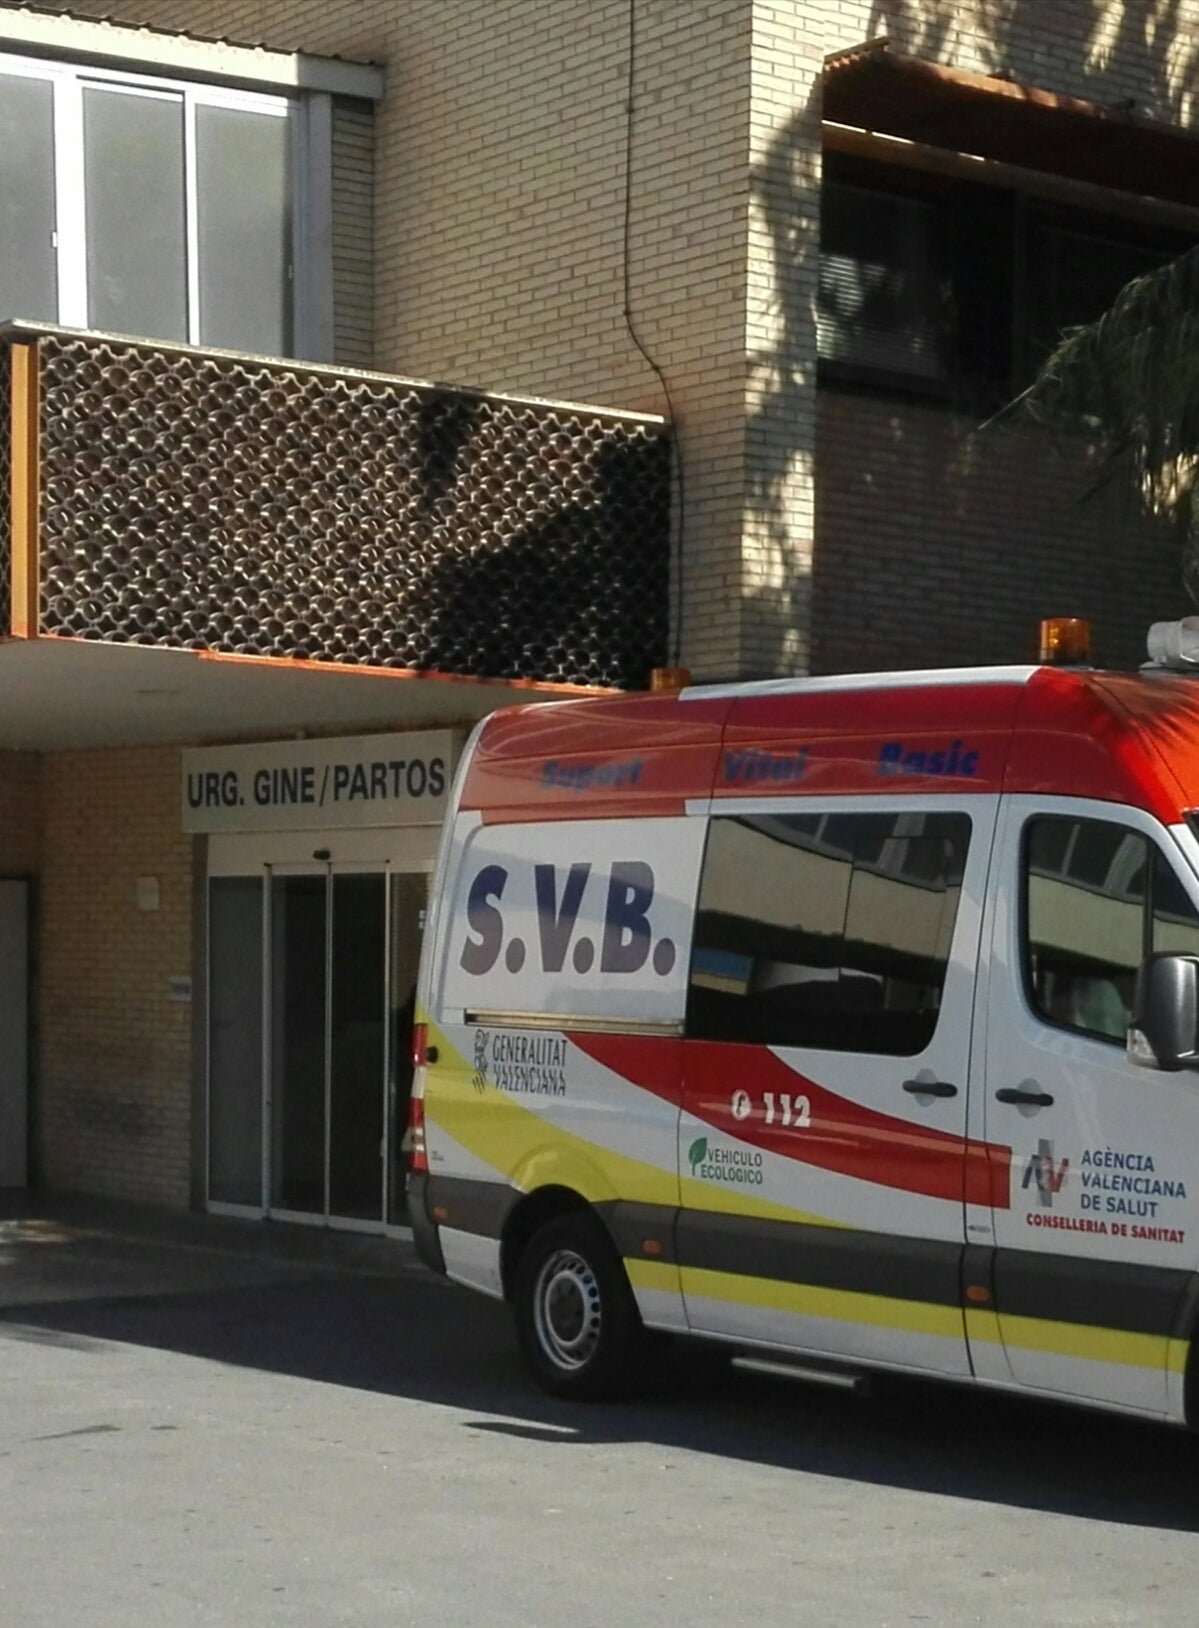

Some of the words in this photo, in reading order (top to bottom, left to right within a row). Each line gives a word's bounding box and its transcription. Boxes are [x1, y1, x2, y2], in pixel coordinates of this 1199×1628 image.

[722, 749, 808, 782] Vital
[187, 770, 245, 808] URG.
[459, 861, 677, 976] S.V.B.
[492, 1034, 568, 1068] GENERALITAT
[493, 1063, 567, 1096] VALENCIANA
[763, 1091, 812, 1128] 112
[708, 1148, 763, 1168] VEHICULO
[1081, 1147, 1155, 1172] AGÈNCIA
[700, 1164, 764, 1185] ECOLOGICO
[1081, 1171, 1187, 1199] VALENCIANA
[1080, 1193, 1101, 1212] DE
[1106, 1197, 1158, 1218] SALUT
[1026, 1213, 1107, 1235] CONSELLERIA
[1111, 1222, 1128, 1237] DE
[1131, 1225, 1185, 1244] SANITAT
